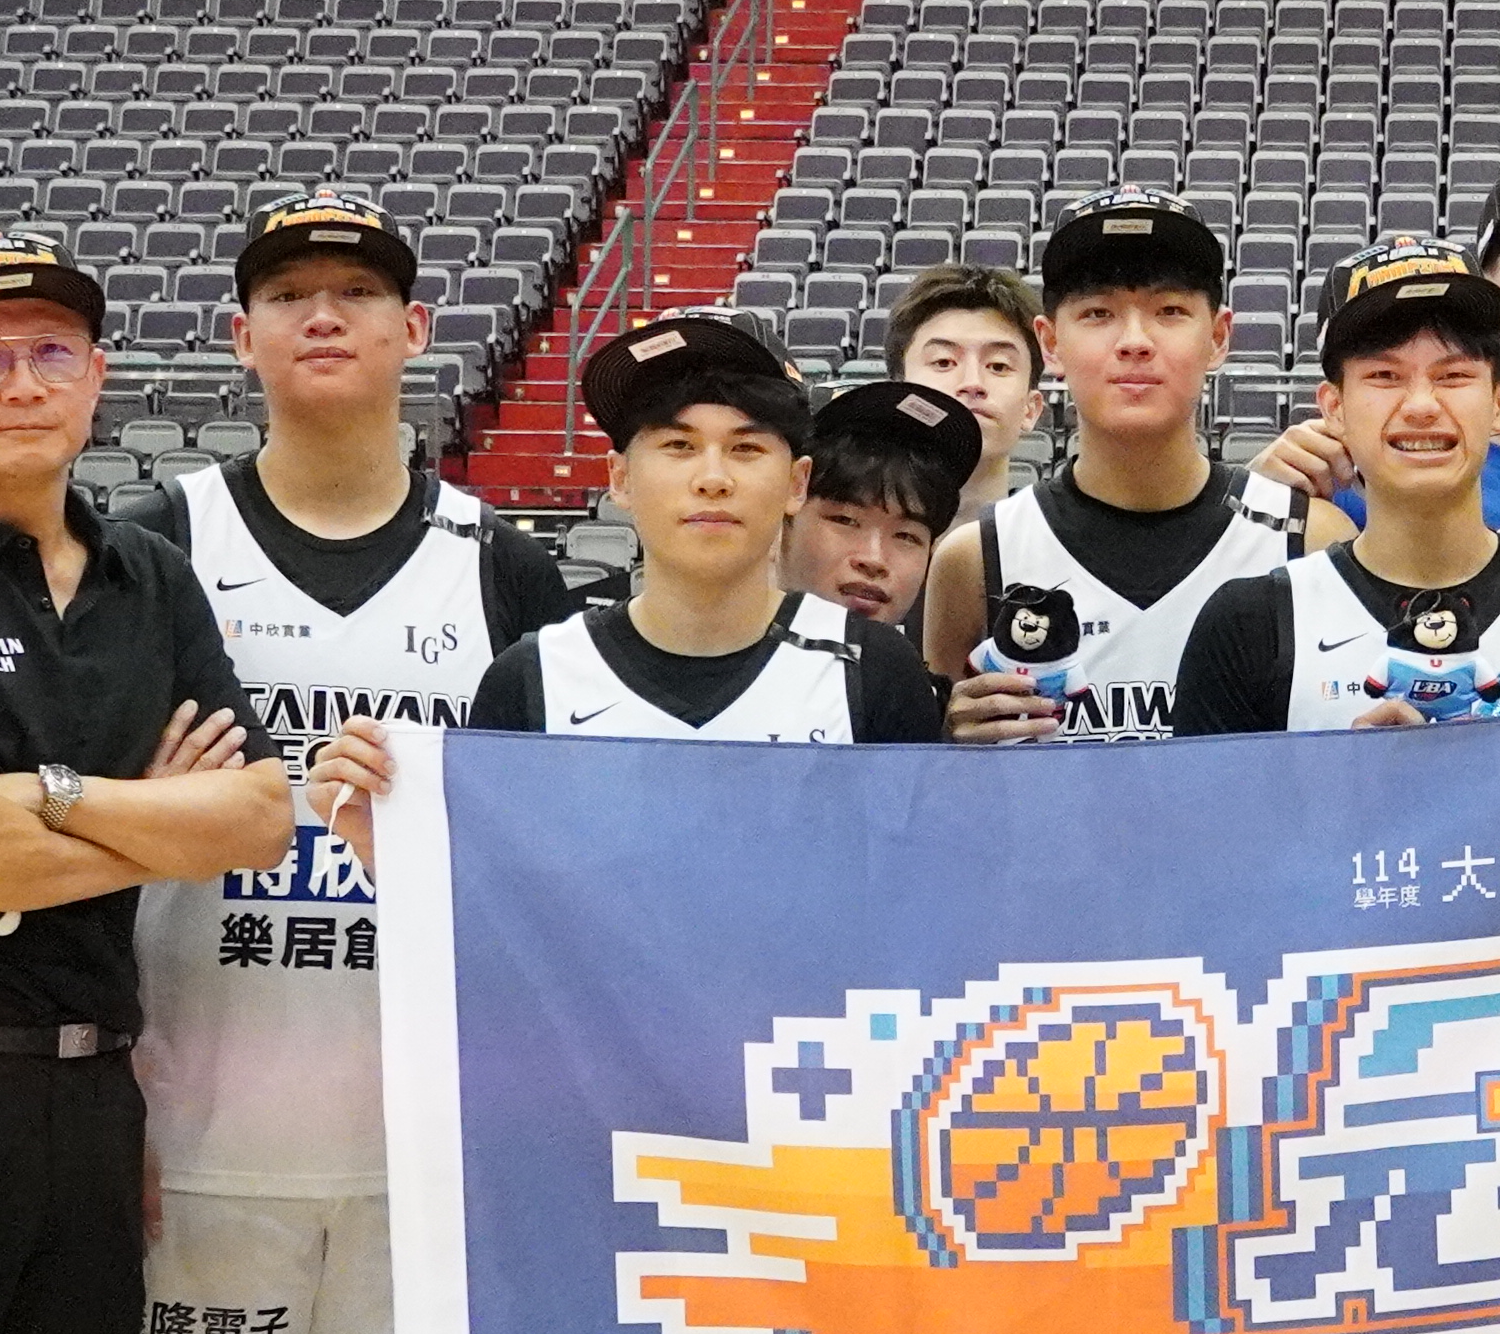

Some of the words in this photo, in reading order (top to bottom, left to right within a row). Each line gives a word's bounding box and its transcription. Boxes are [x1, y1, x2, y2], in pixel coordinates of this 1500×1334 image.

[404, 623, 458, 665] IGS
[1352, 848, 1420, 884] 114
[1353, 885, 1421, 910] 學年度
